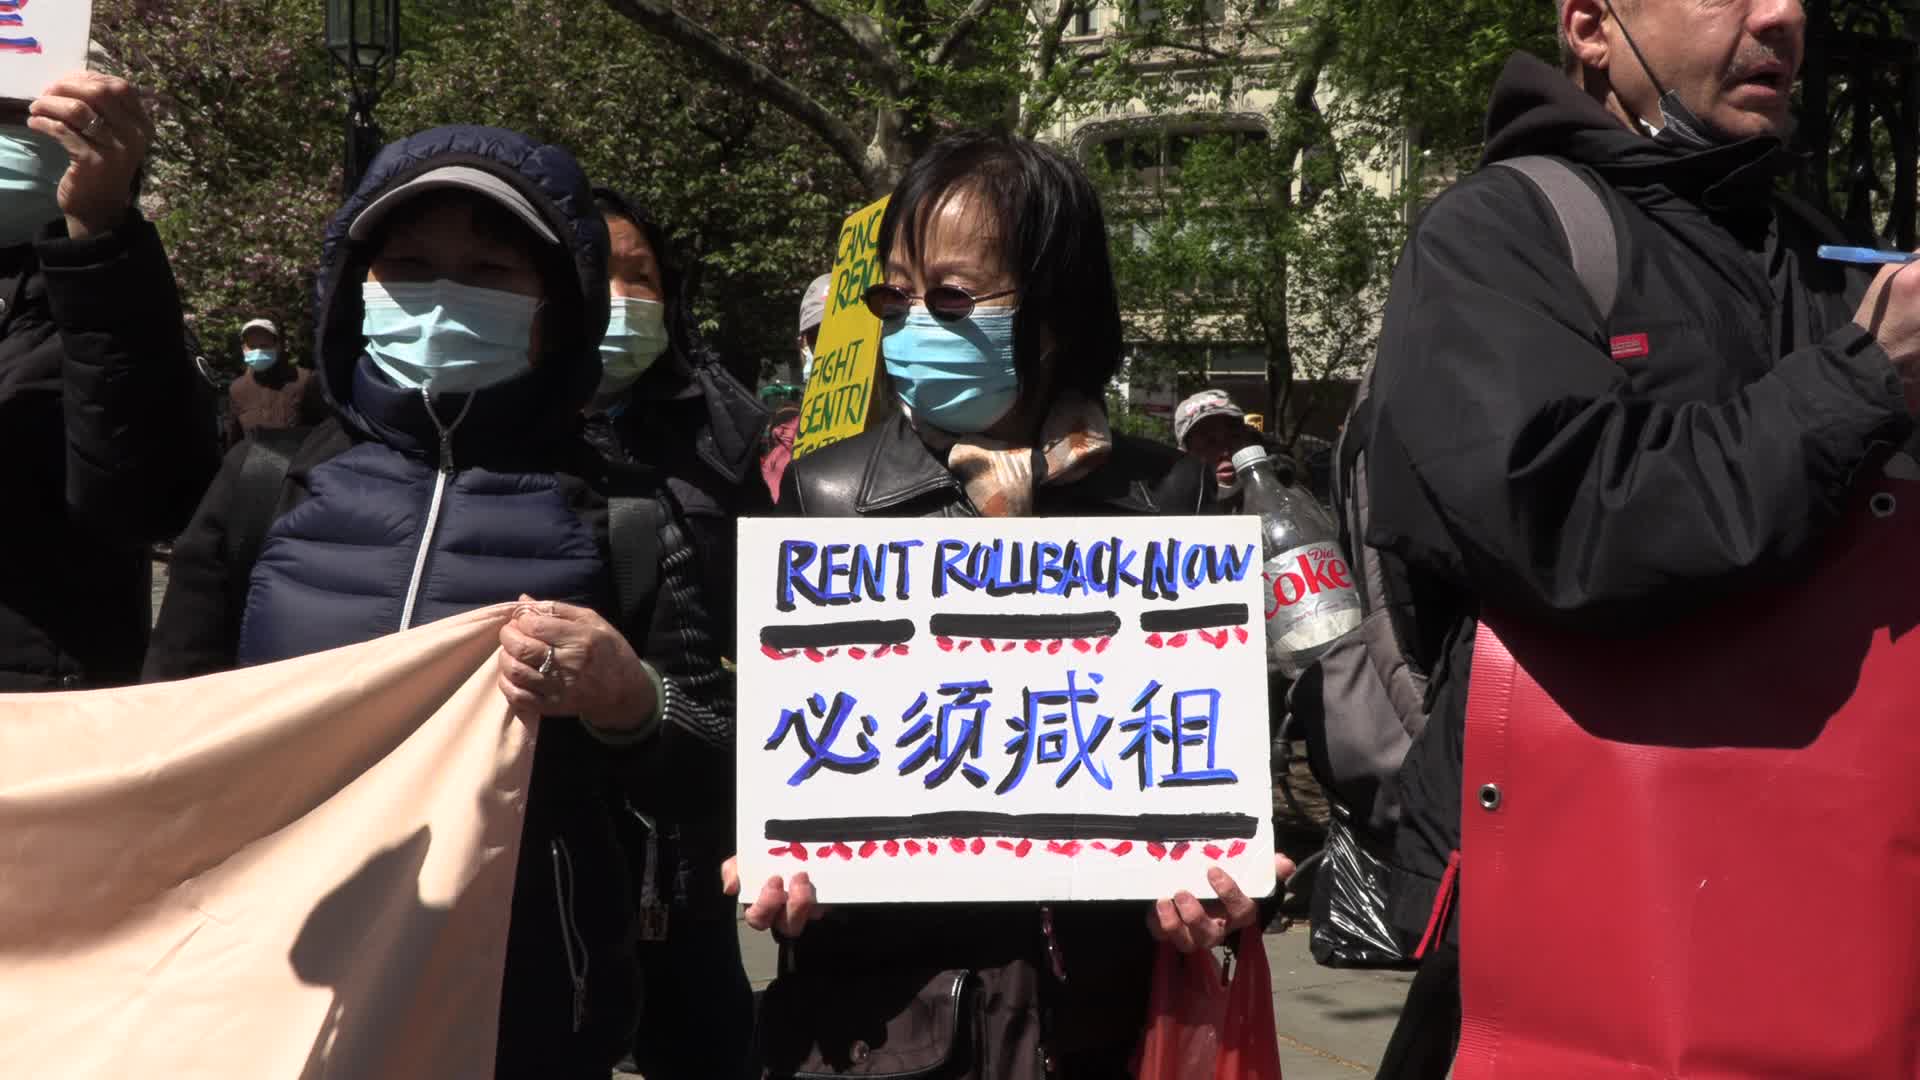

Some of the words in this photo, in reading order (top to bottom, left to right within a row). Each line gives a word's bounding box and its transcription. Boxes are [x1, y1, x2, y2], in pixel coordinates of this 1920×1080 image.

[836, 208, 883, 266] CANC
[807, 338, 865, 392] FIGHT
[797, 376, 869, 439] GENTRI
[776, 539, 923, 611] RENT
[932, 536, 1143, 599] ROLLBACK
[1141, 538, 1255, 601] NOW
[1308, 546, 1335, 561] Diet
[764, 670, 1239, 795] 必须减租
